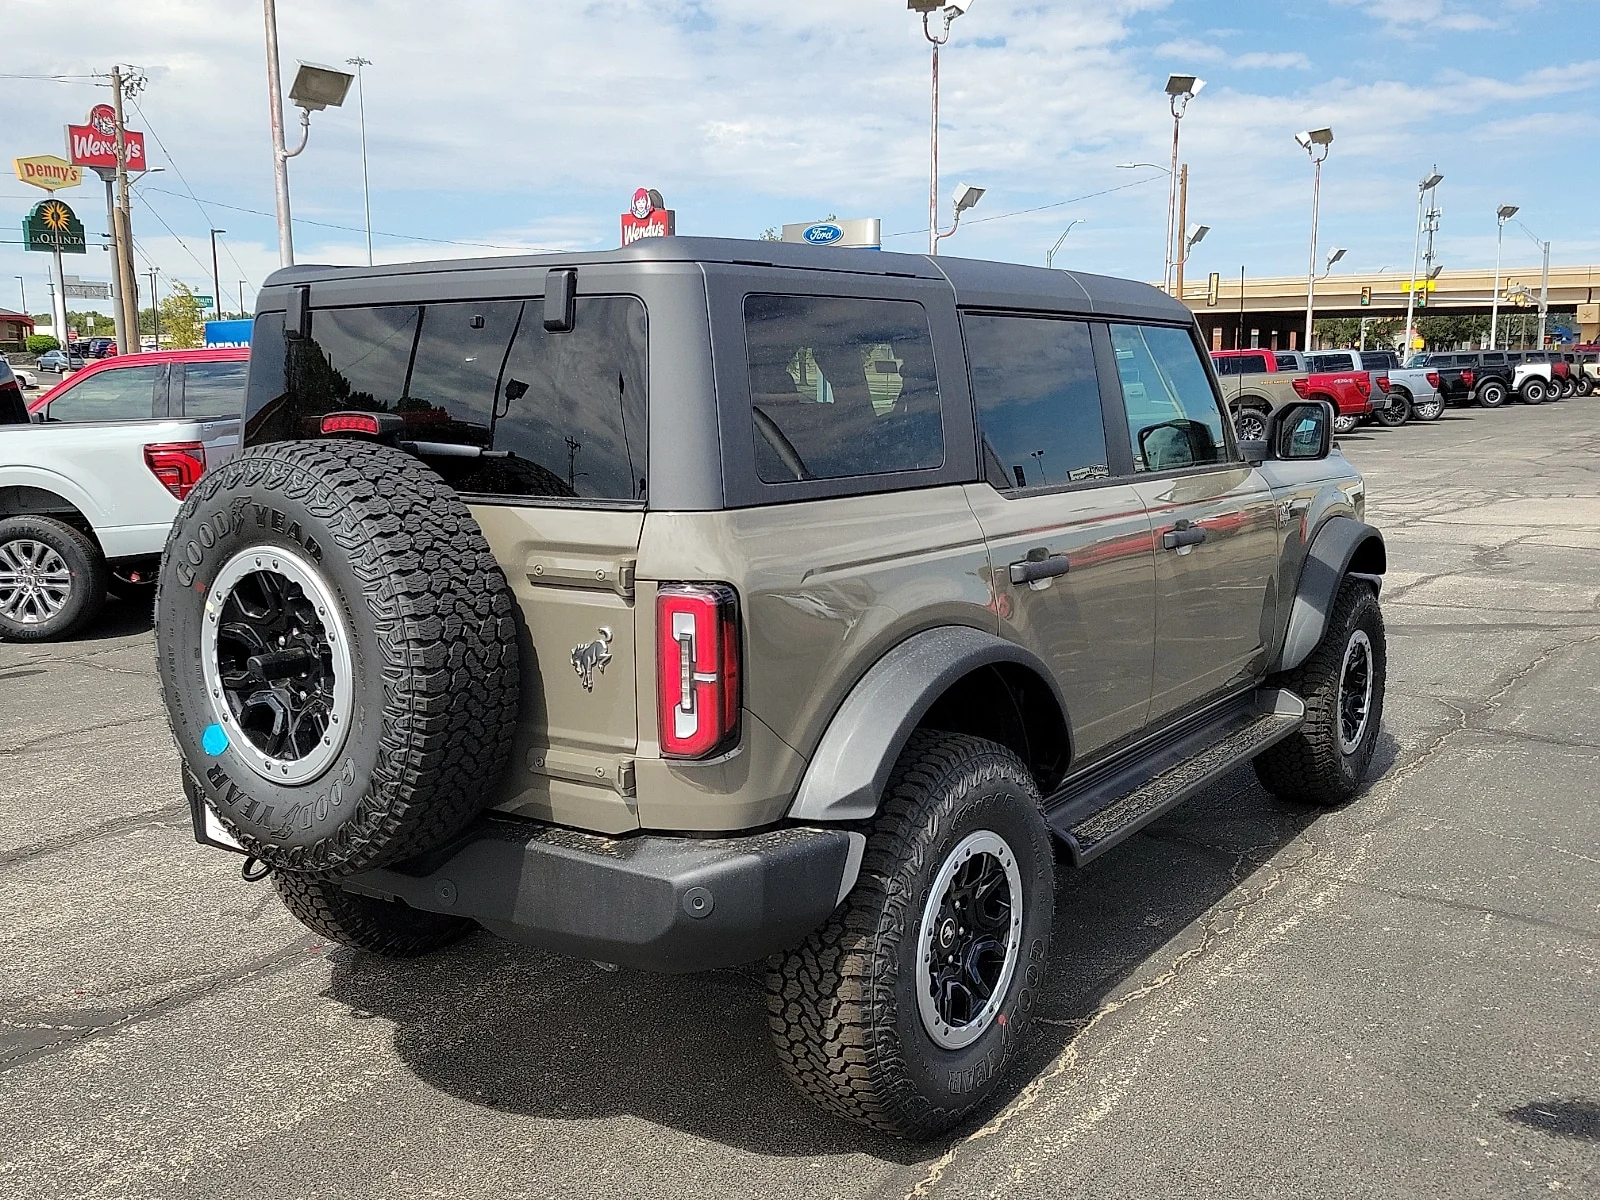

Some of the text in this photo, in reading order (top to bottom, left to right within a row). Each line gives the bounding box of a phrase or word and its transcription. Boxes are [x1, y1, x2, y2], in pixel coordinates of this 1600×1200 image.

[23, 162, 78, 182] Denny's
[623, 217, 665, 246] Wendy's
[809, 226, 834, 240] Ford
[176, 497, 324, 588] GOODYEAR
